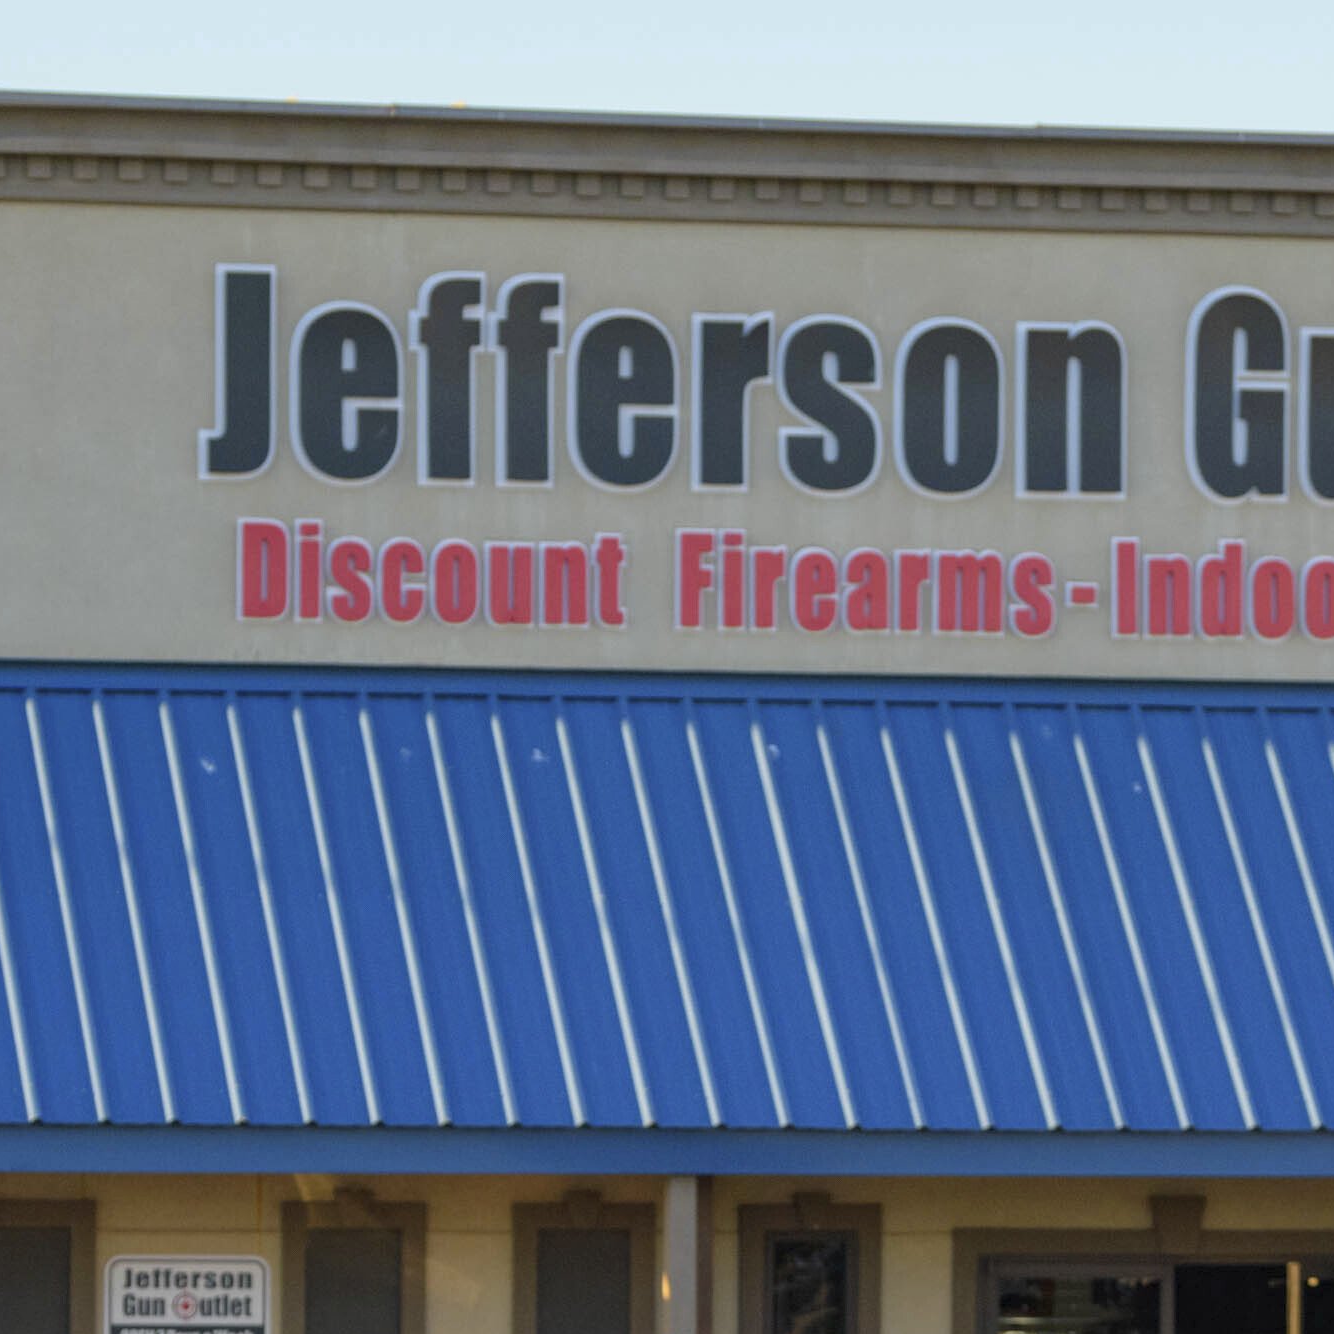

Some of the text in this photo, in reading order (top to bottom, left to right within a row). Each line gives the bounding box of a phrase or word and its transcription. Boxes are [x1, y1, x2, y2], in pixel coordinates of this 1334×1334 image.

[200, 264, 1126, 499] Jefferson
[236, 519, 626, 628] Discount
[122, 1293, 166, 1317] Gun
[124, 1268, 253, 1289] Jefferson
